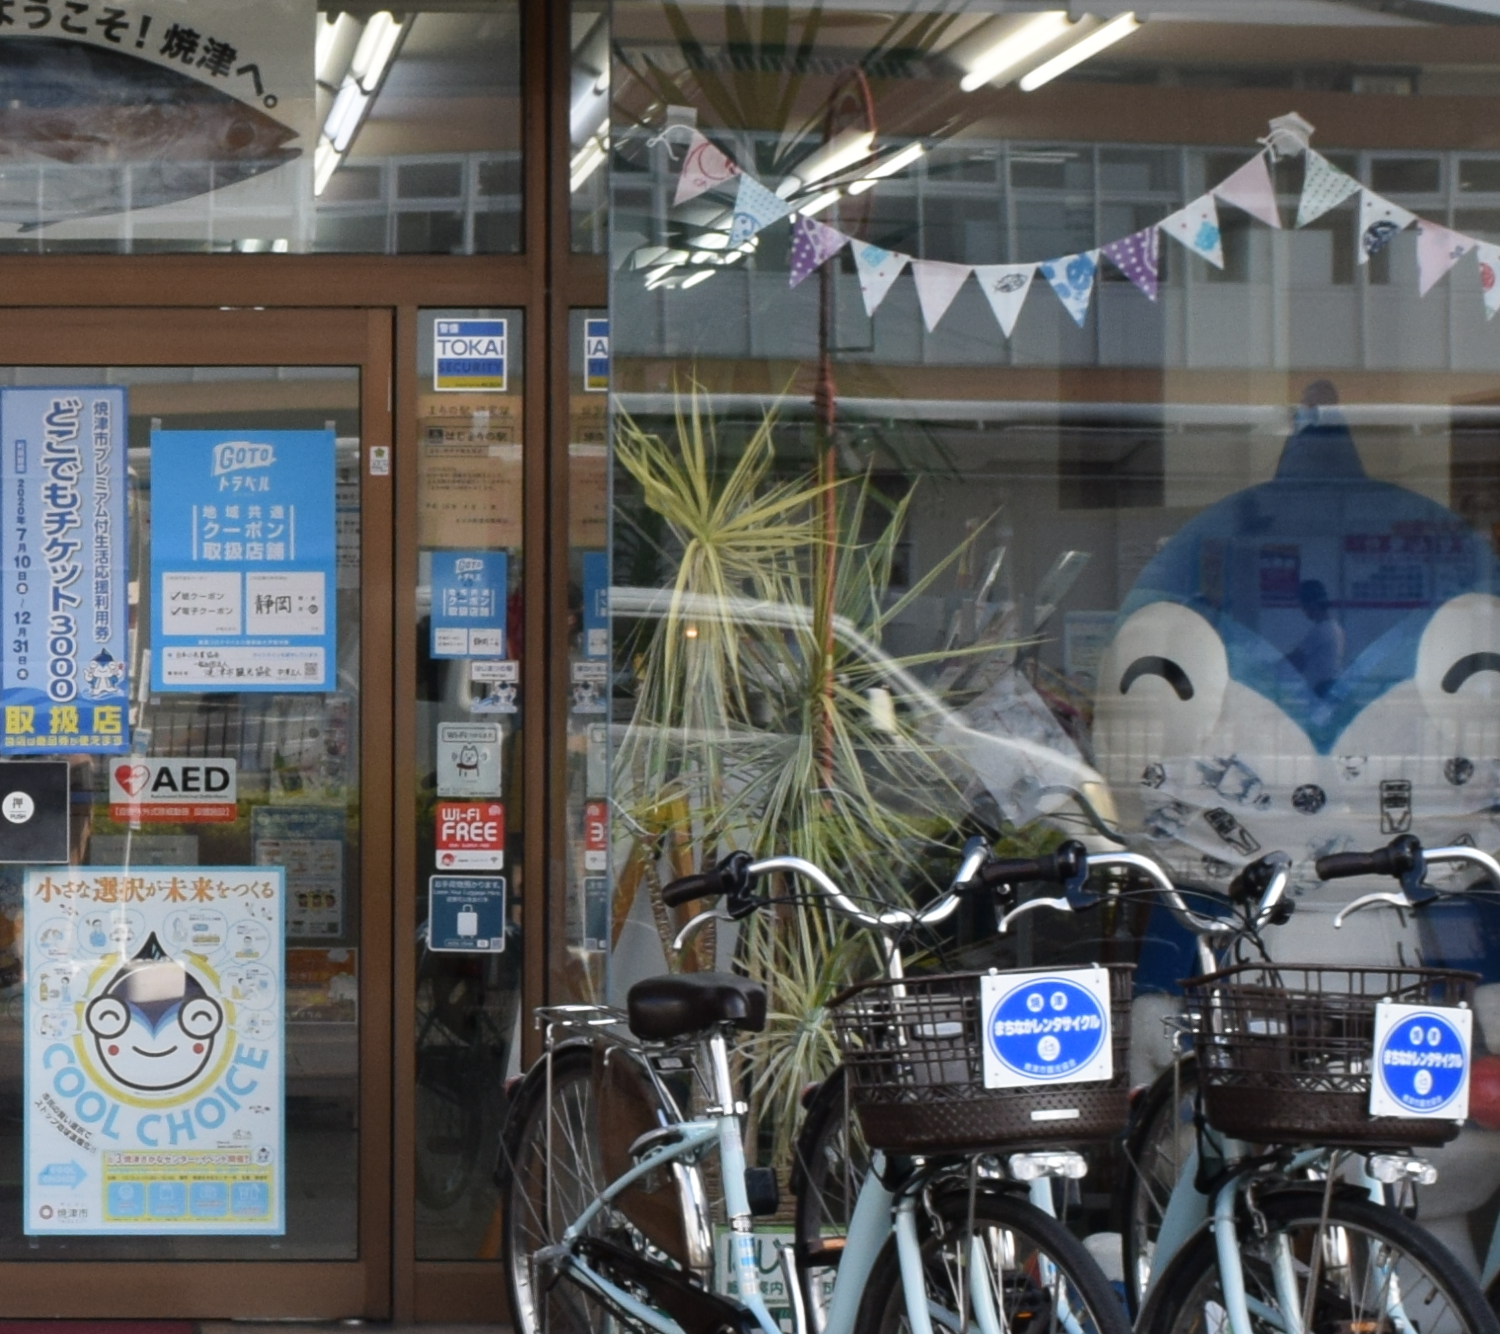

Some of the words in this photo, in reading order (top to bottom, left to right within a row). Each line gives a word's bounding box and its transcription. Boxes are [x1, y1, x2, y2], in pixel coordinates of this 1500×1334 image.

[437, 339, 505, 356] TOKAI
[219, 475, 271, 492] トラベル
[202, 521, 285, 539] クーポン
[42, 397, 82, 703] どこでもチケット3000
[254, 593, 292, 616] 静岡
[4, 704, 123, 735] 取扱店
[151, 766, 231, 793] AED
[441, 808, 481, 821] Wi-Fi
[441, 821, 498, 842] FREE
[34, 875, 275, 904] 小さな選択が未来をつくる
[42, 1042, 121, 1140] COOL
[135, 1043, 269, 1147] CHOICE
